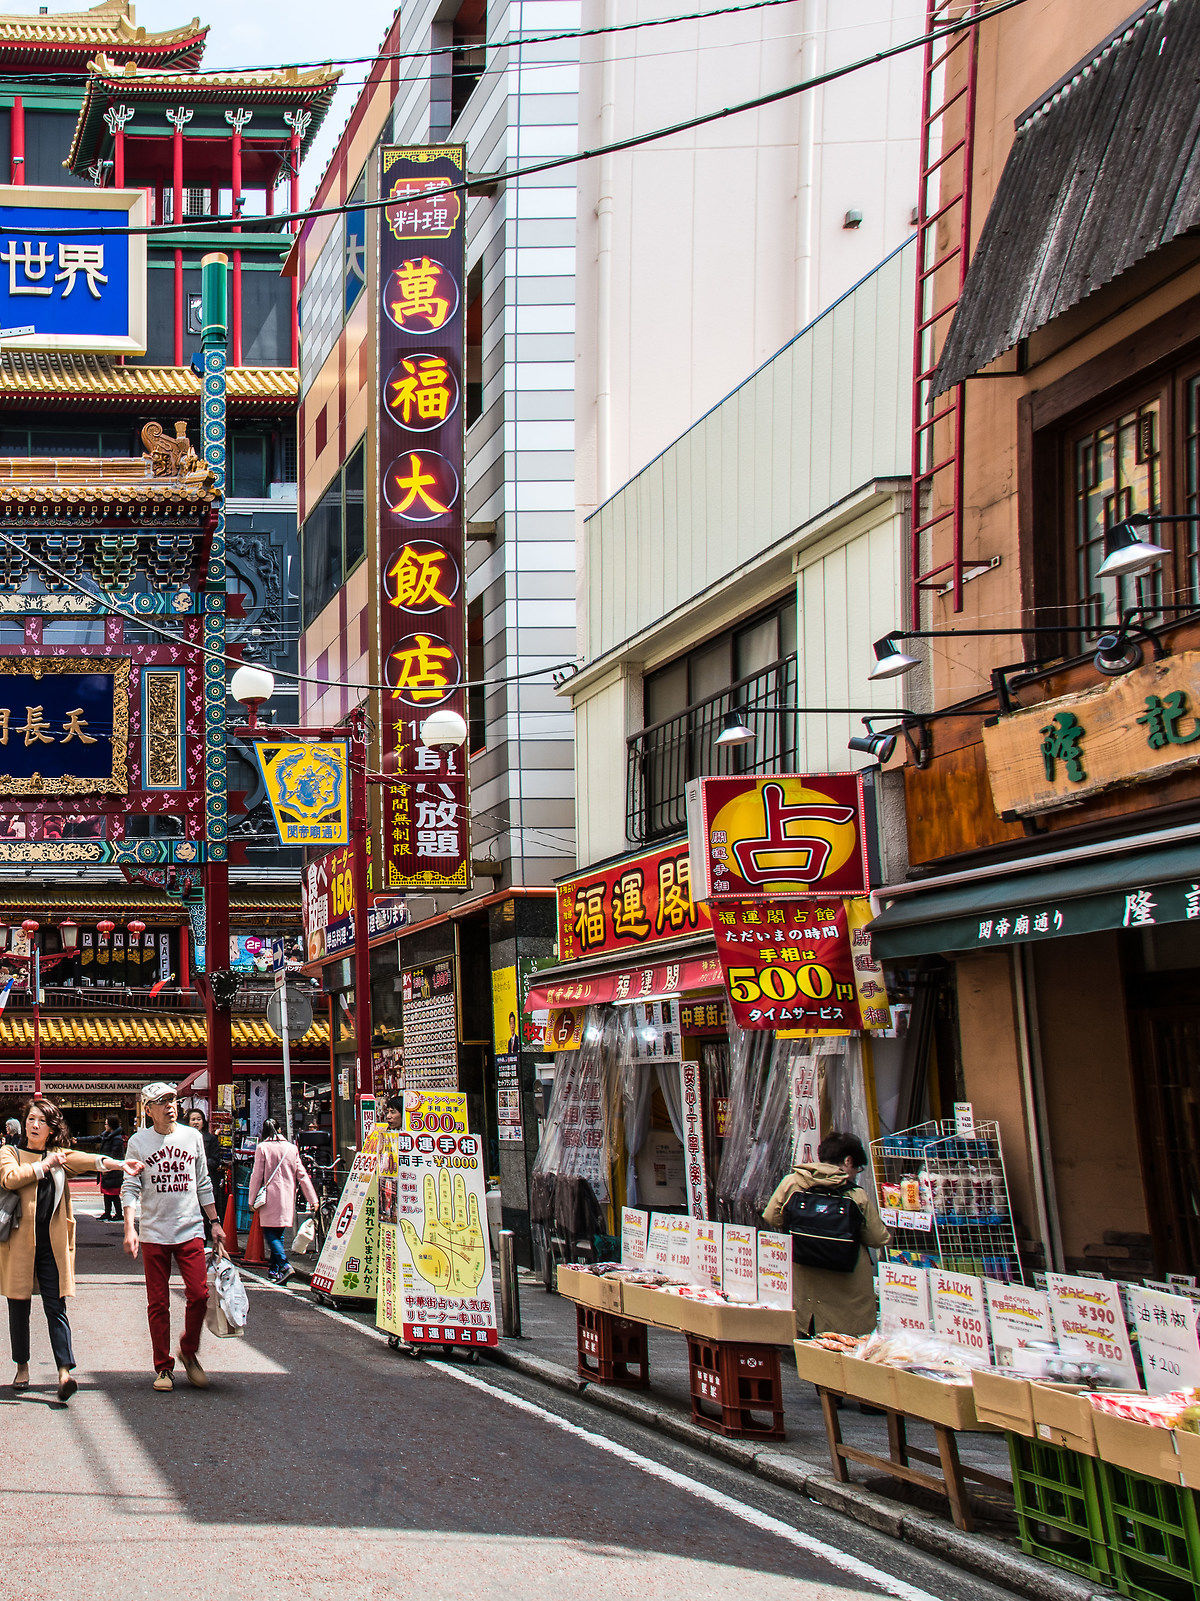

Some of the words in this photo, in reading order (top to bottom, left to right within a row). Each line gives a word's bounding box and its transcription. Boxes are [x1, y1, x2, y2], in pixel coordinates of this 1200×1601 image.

[395, 181, 447, 207] 中華
[394, 208, 450, 233] 料理
[388, 256, 456, 701] 萬福大飯店
[287, 825, 343, 839] 関帝廟通り
[732, 783, 856, 885] 占
[574, 856, 696, 949] 福運閣
[718, 908, 836, 925] 福運閣占館
[978, 909, 1064, 940] 関帝廟通り
[725, 925, 839, 942] ただいまの時間
[246, 941, 261, 949] 2F
[161, 936, 169, 980] CAFE
[759, 947, 817, 963] 手相は
[615, 965, 680, 999] 福運閣
[728, 963, 853, 1003] 500円
[749, 1007, 844, 1022] タイムサービス
[419, 1095, 466, 1106] キャンペーン
[409, 1112, 465, 1133] 500円
[398, 1135, 477, 1155] 開運手相
[145, 1149, 166, 1167] NEW
[166, 1145, 194, 1165] YORK
[158, 1161, 185, 1173] 1946
[151, 1175, 171, 1184] EAST
[174, 1174, 193, 1183] ATHL
[156, 1183, 189, 1193] LEAGUE
[704, 1244, 717, 1253] ¥550
[771, 1250, 787, 1261] ¥500
[346, 1257, 360, 1272] 占
[771, 1280, 787, 1291] ¥500
[886, 1271, 917, 1287] 干しエビ
[938, 1279, 972, 1297] えいひれ
[1053, 1284, 1111, 1303] うずらピータン
[405, 1296, 491, 1312] 中華街占い人気店
[1077, 1305, 1115, 1324] ¥390
[1137, 1303, 1188, 1330] 油辣椒
[953, 1315, 981, 1333] ¥650
[1062, 1320, 1115, 1339] 松花ピータン
[412, 1326, 488, 1342] 福運閣占館
[1085, 1340, 1122, 1361] ¥450
[1148, 1354, 1180, 1376] ¥200
